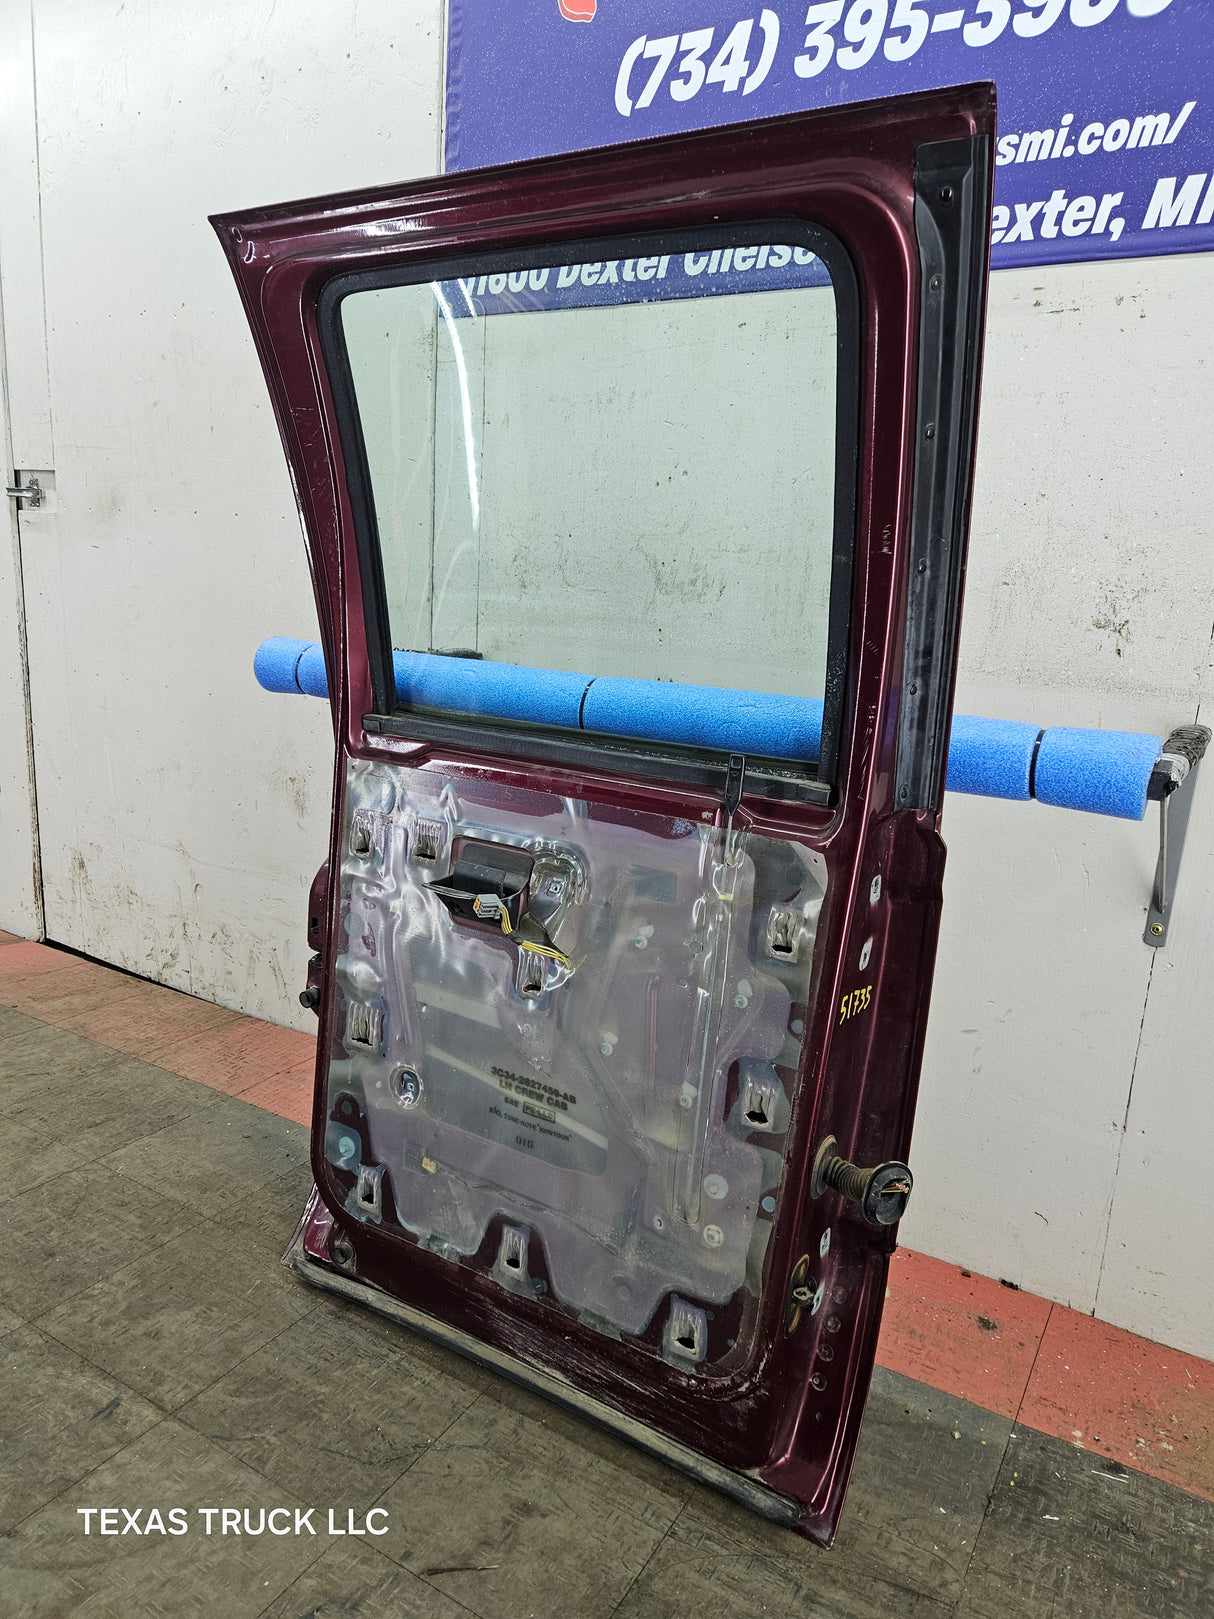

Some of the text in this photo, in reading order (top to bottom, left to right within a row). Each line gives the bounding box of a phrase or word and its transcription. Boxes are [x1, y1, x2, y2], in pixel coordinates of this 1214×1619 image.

[615, 0, 1173, 117] (734) 395-3
[991, 101, 1197, 166] smi.com/
[991, 190, 1125, 245] exter,
[839, 985, 873, 1025] 51735
[499, 1080, 569, 1112] LH CREW CAB
